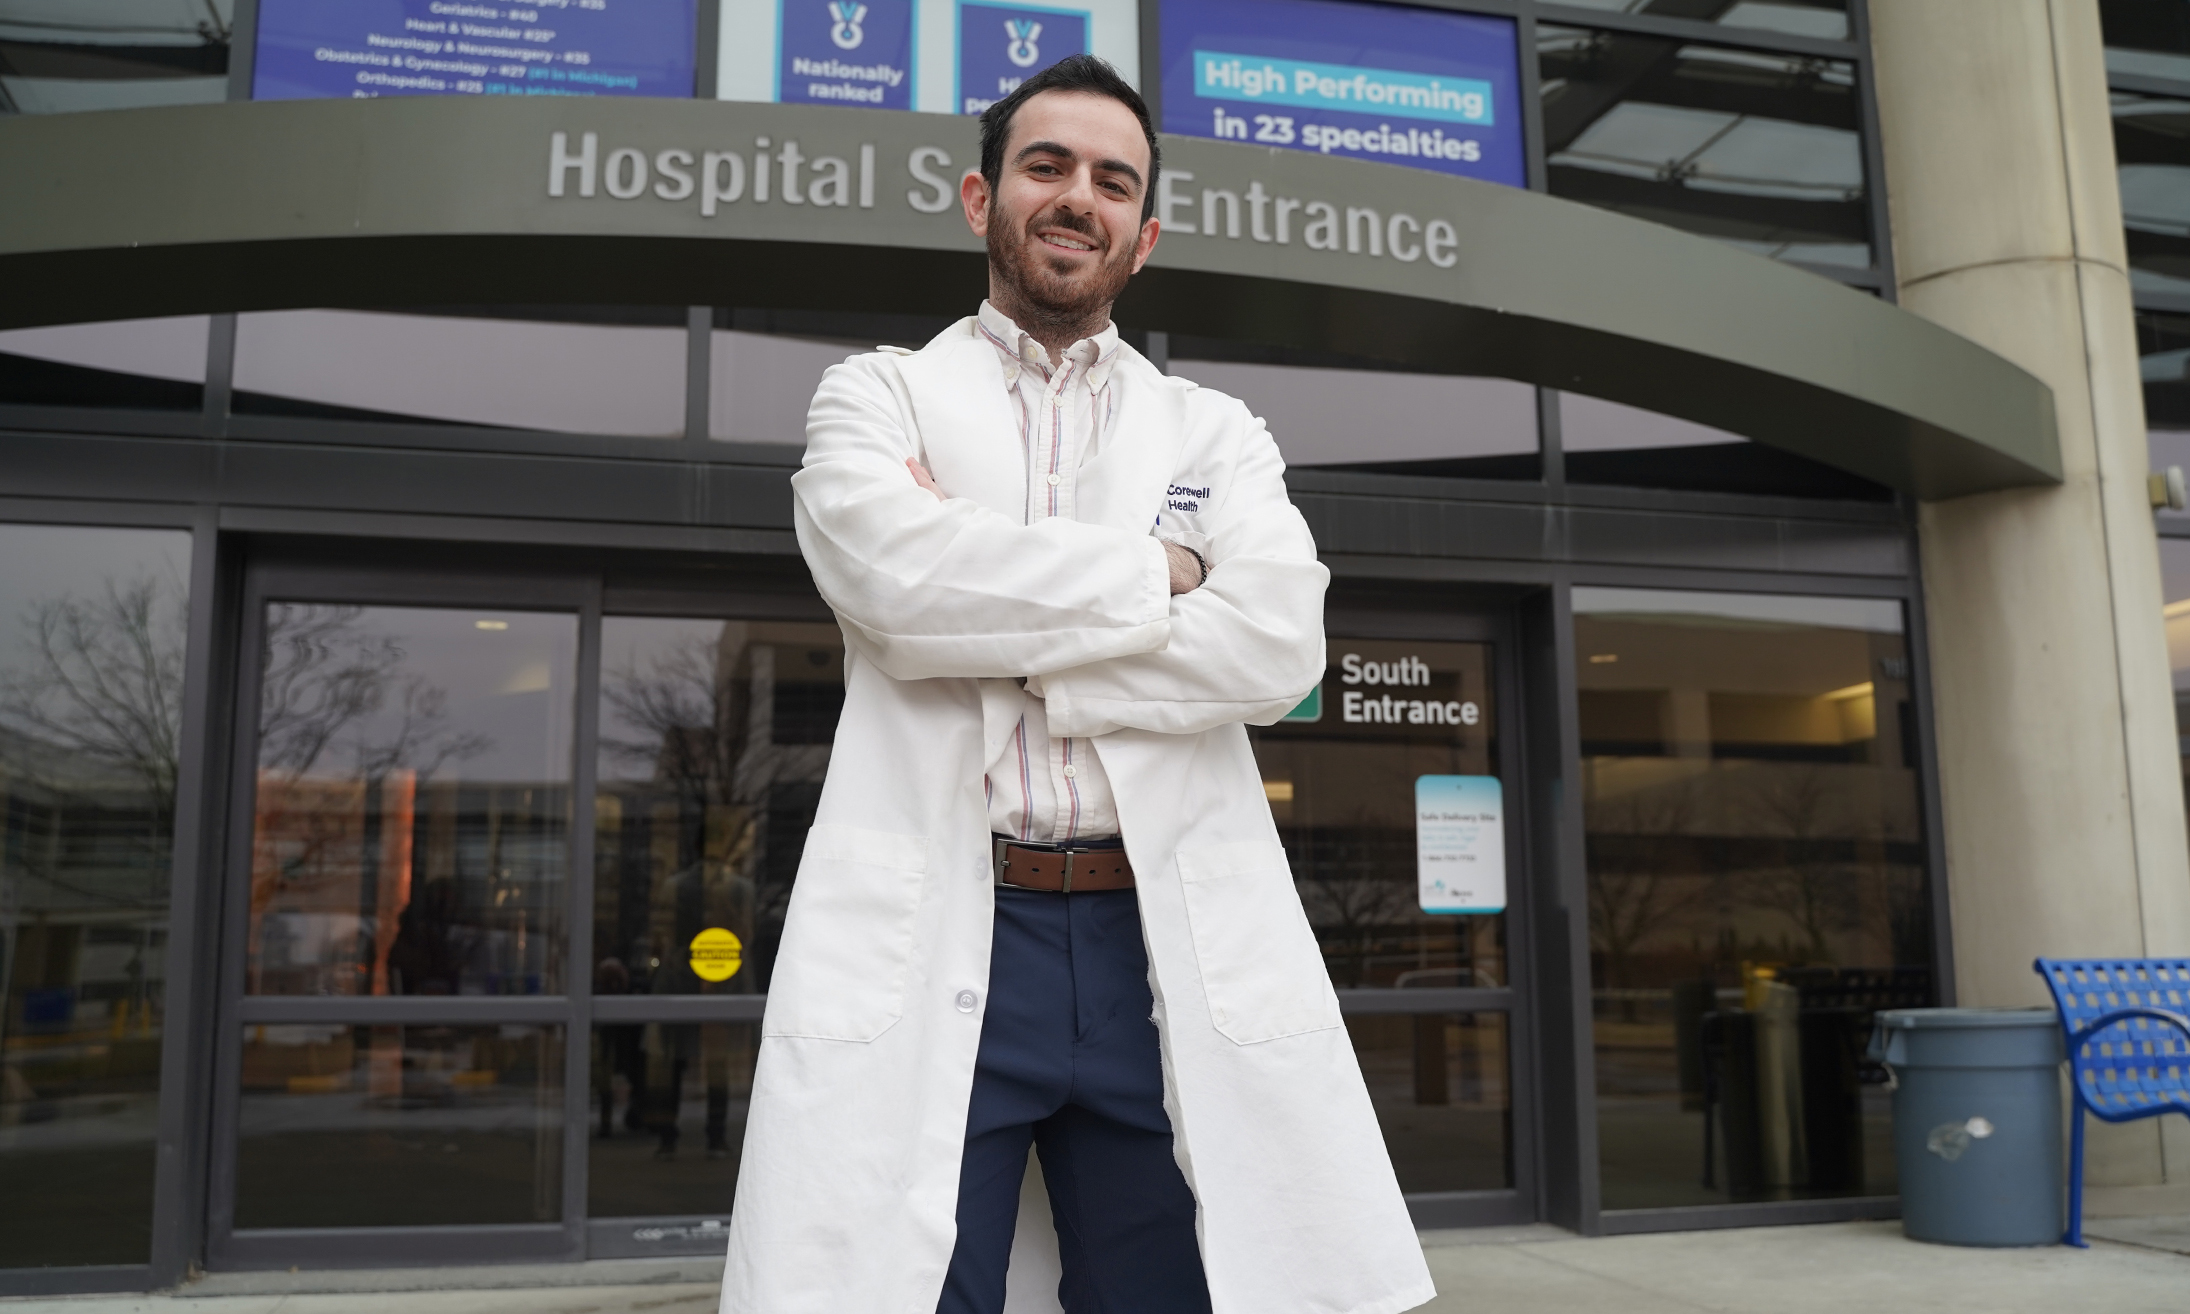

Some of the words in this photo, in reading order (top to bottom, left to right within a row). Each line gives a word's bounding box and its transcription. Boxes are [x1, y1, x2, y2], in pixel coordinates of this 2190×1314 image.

[429, 1, 498, 19] Geriatrics
[405, 17, 446, 34] Heart
[448, 21, 459, 34] &
[461, 23, 522, 40] Vascular
[314, 47, 390, 67] Obstetrics
[391, 54, 403, 68] &
[404, 55, 489, 77] Gynecology
[498, 64, 527, 78] #27
[551, 67, 566, 81] in
[367, 32, 443, 54] Neurology
[443, 40, 455, 53] &
[457, 41, 554, 64] Neurosurgery
[355, 70, 446, 91] Orthopedics
[793, 57, 903, 86] Nationally
[808, 82, 883, 103] ranked
[1205, 60, 1286, 97] High
[1294, 70, 1484, 120] Performing
[1213, 107, 1247, 140] in
[1253, 114, 1296, 145] 23
[1301, 123, 1481, 162] specialties
[547, 131, 875, 217] Hospital
[1157, 169, 1459, 268] Entrance
[1167, 484, 1210, 498] Corewell
[1168, 500, 1198, 512] Health
[1341, 653, 1431, 686] South
[1342, 690, 1479, 725] Entrance
